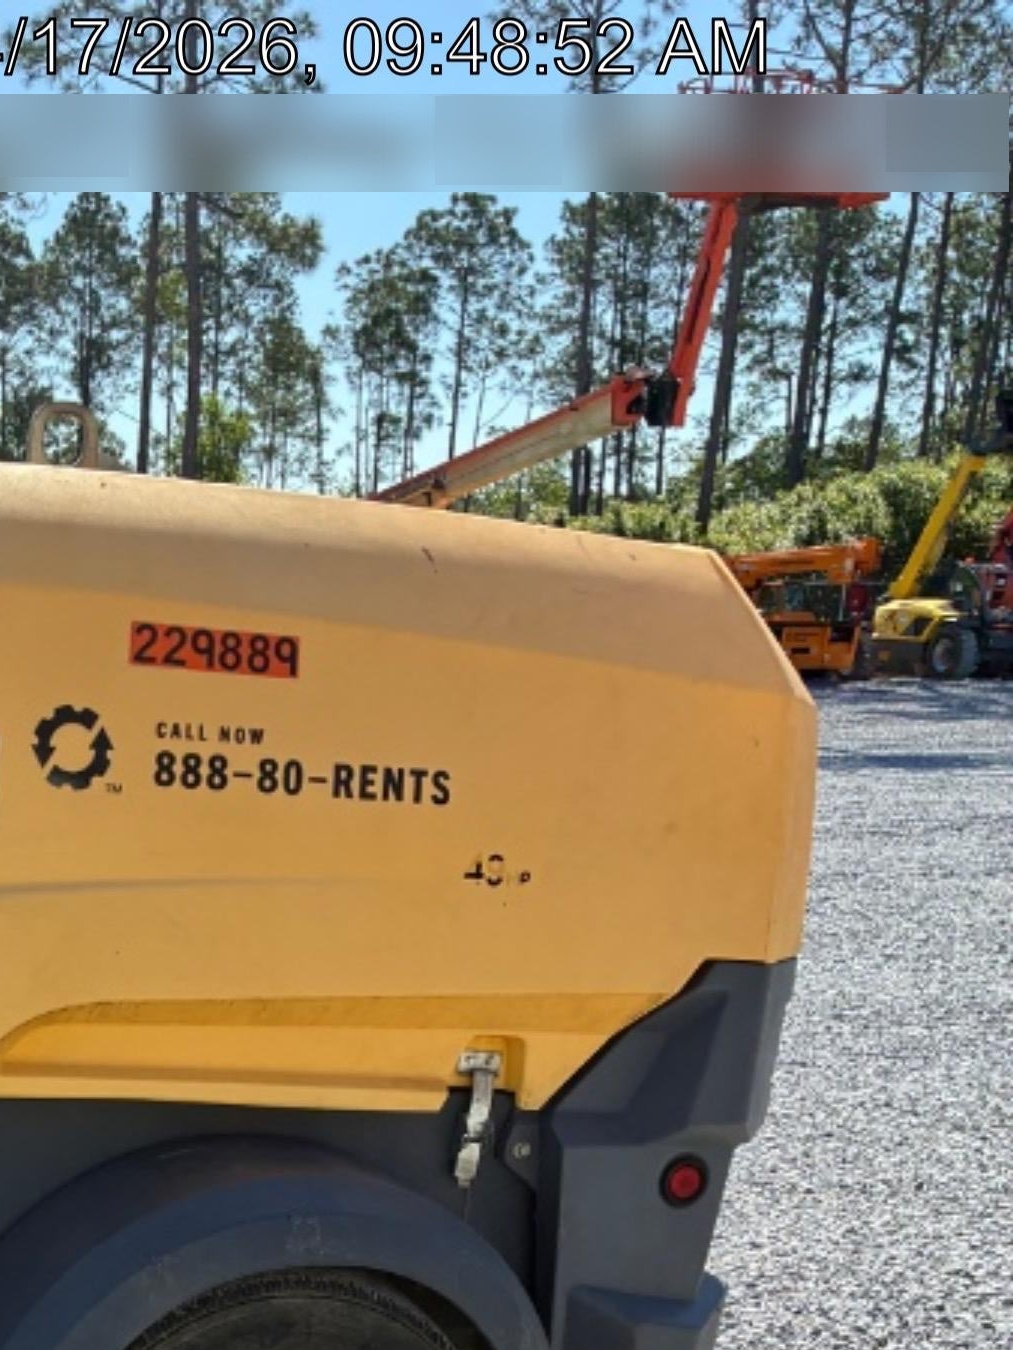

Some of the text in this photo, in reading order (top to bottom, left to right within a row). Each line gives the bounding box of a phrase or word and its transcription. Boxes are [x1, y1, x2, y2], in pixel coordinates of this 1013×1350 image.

[133, 623, 298, 677] 229889
[155, 721, 265, 745] CALL NOW
[153, 750, 451, 806] 888-80-RENTS
